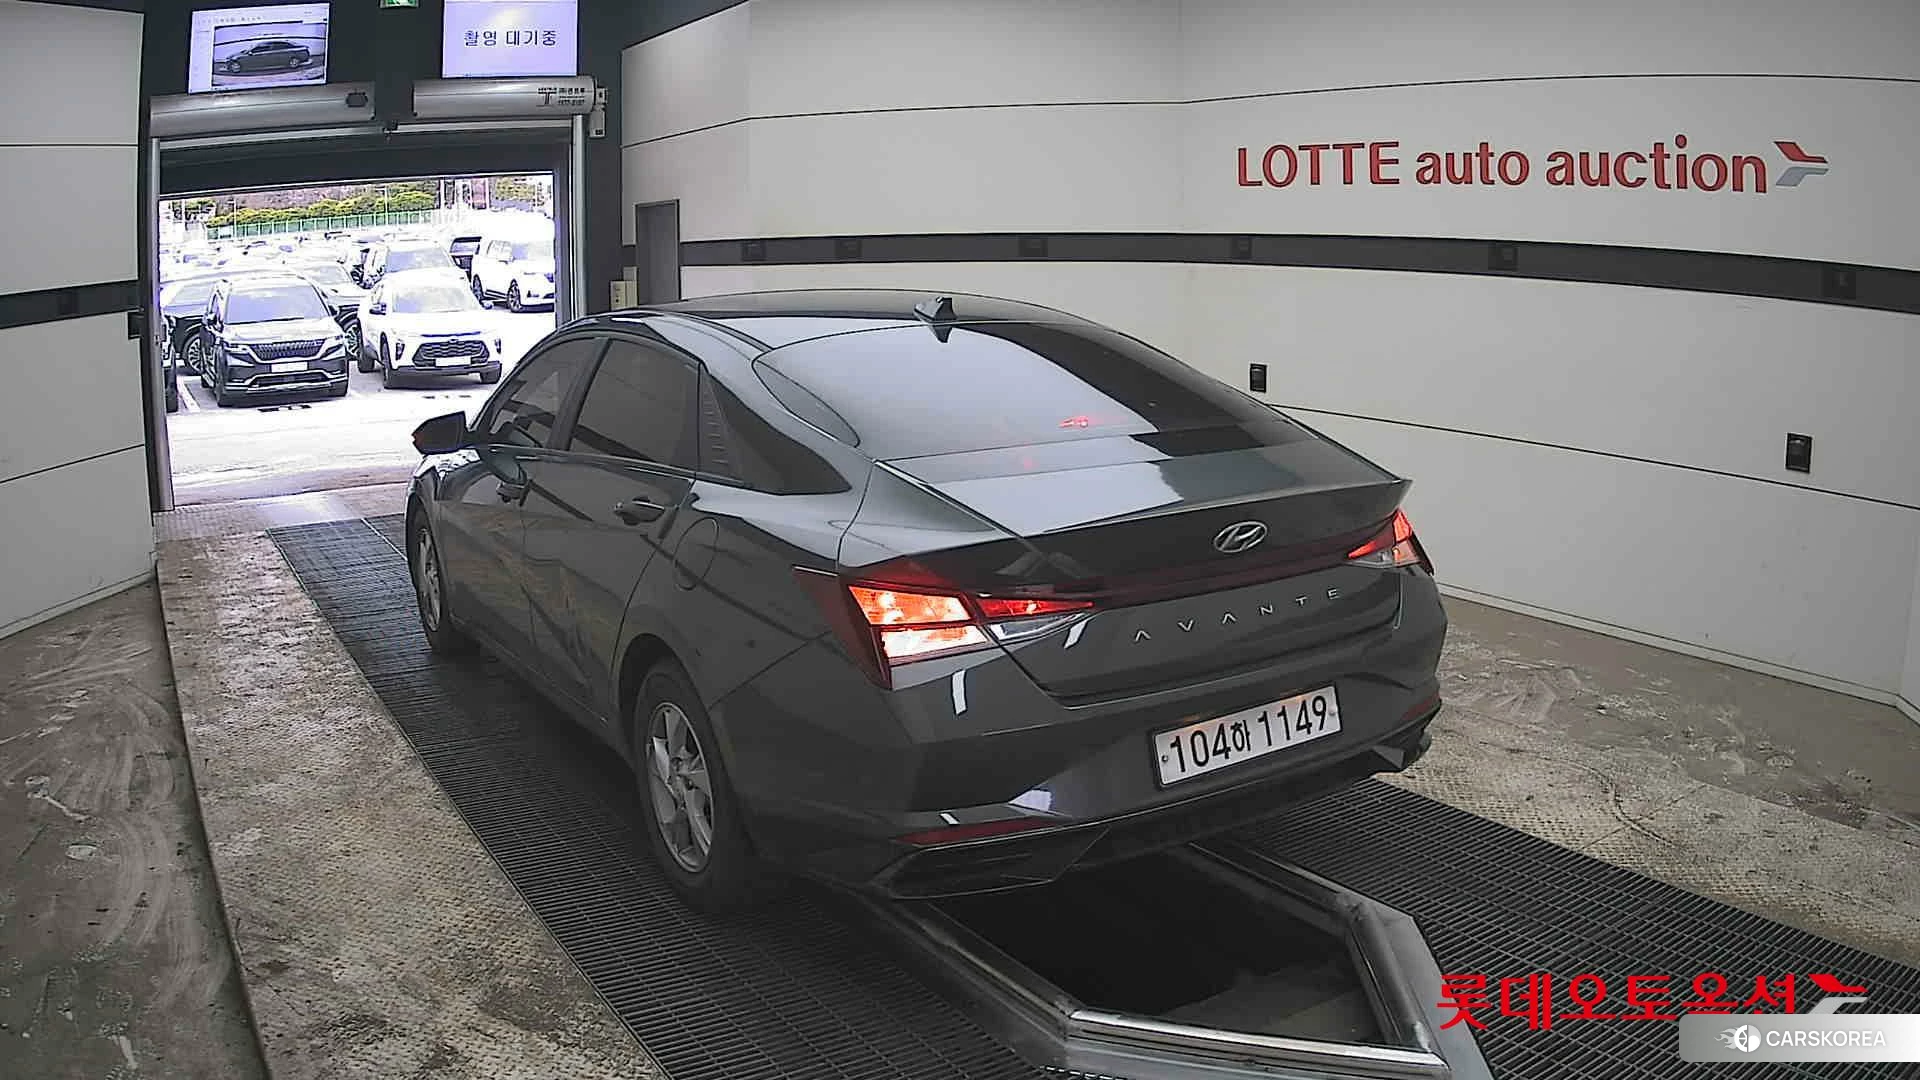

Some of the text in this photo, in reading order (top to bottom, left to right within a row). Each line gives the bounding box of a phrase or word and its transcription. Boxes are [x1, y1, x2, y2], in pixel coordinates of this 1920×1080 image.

[464, 30, 557, 46] 촬영 대기중
[1237, 134, 1767, 193] LOTTE auto auction
[1134, 588, 1339, 642] AVANTE
[1258, 695, 1327, 747] 1149
